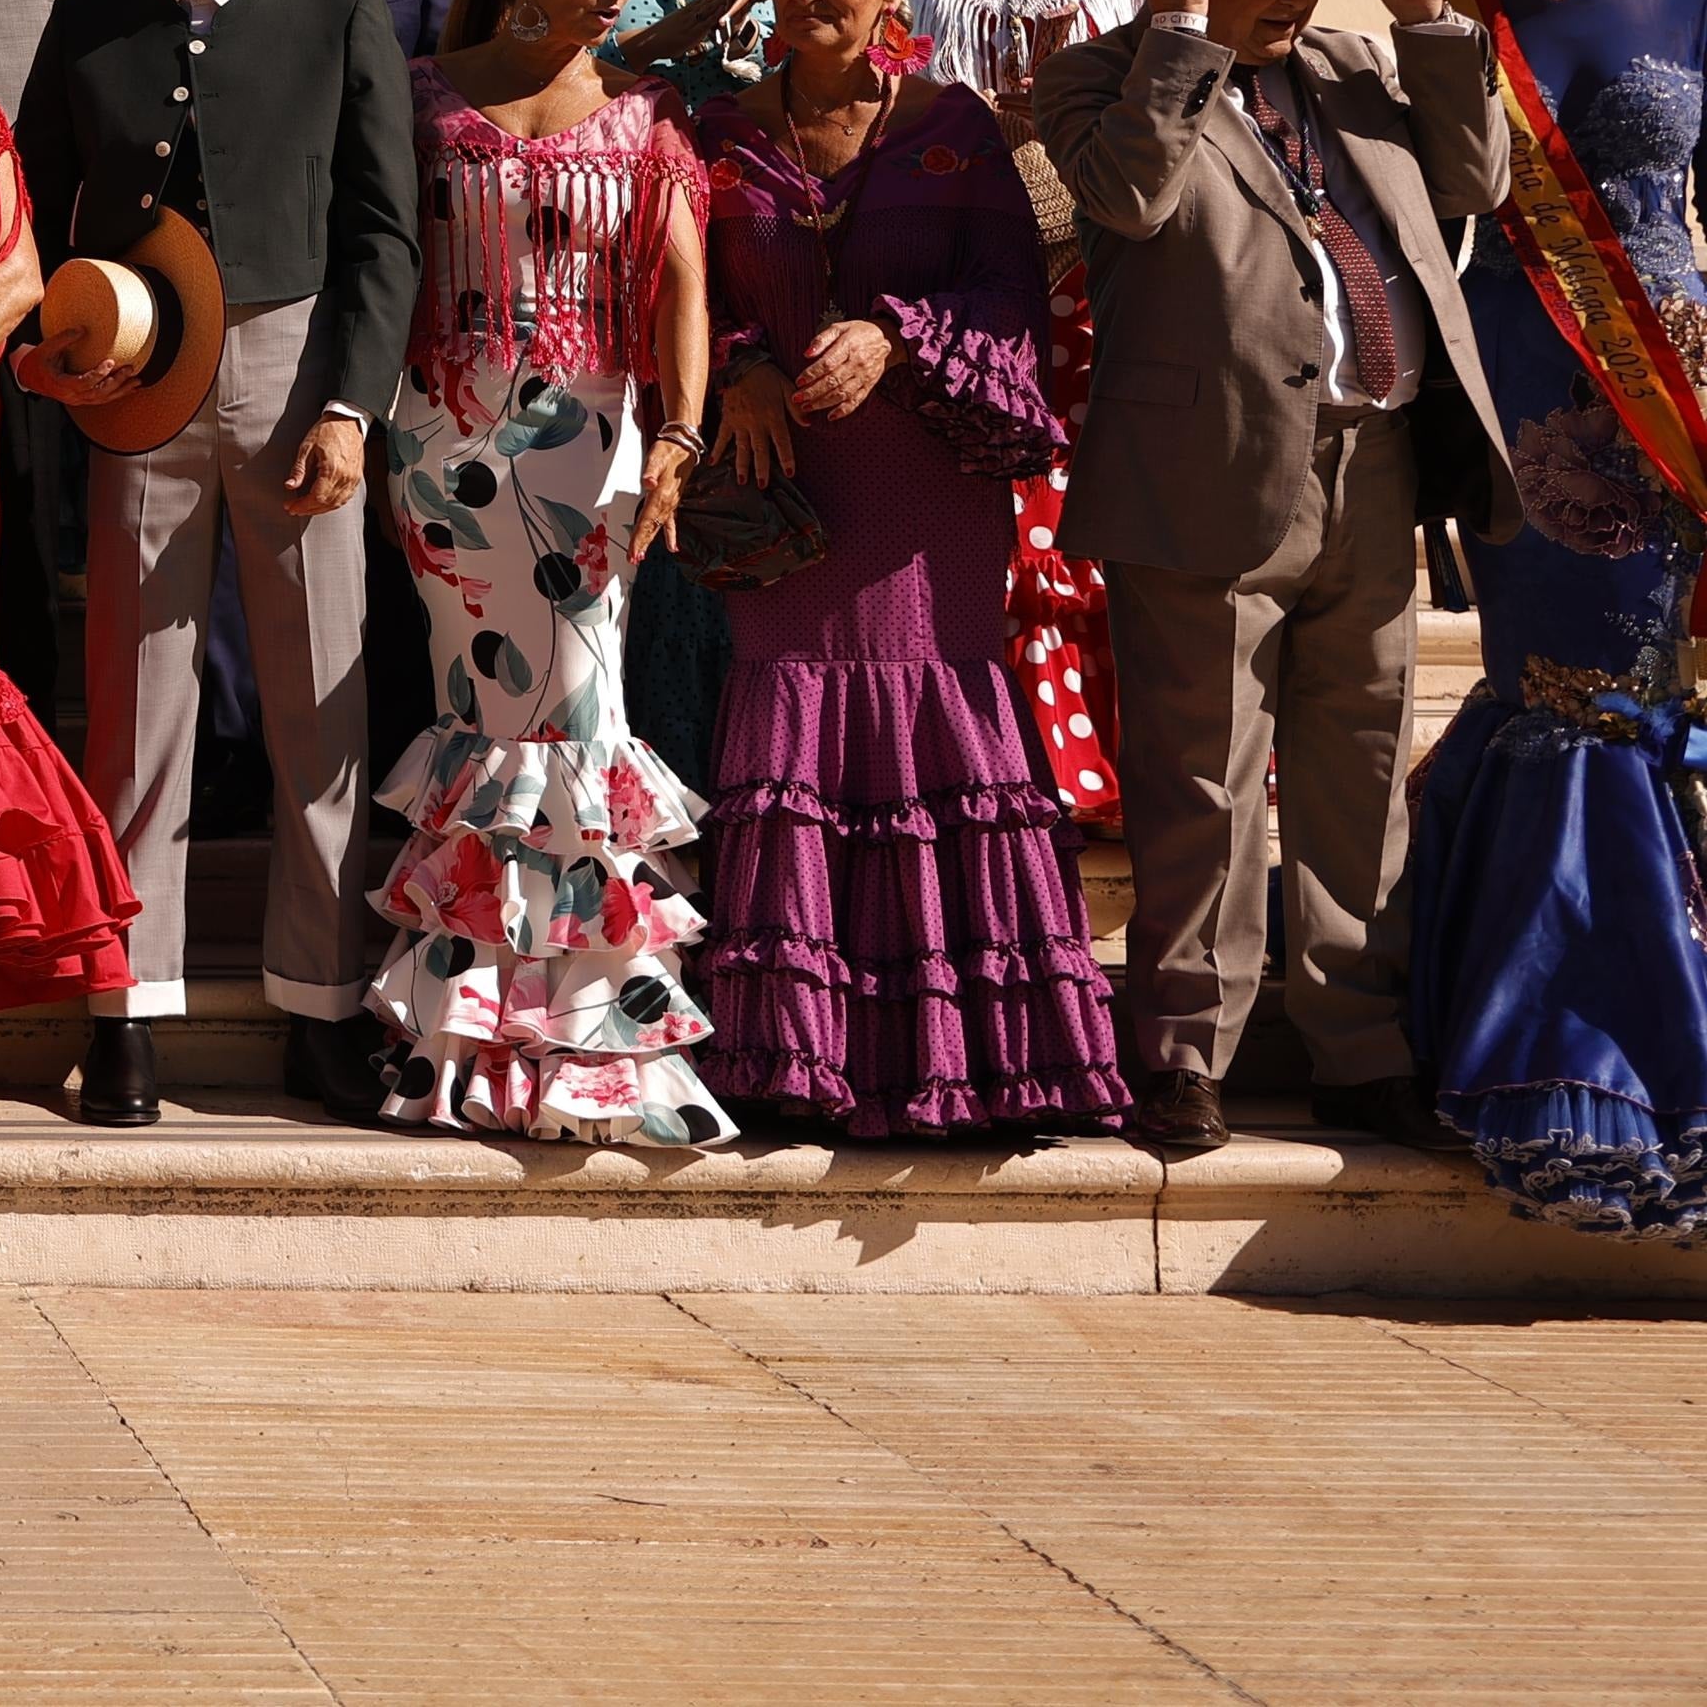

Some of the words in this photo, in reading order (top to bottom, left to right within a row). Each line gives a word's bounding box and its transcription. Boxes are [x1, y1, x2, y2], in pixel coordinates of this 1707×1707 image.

[1170, 15, 1197, 25] CITY
[1531, 203, 1570, 227] de
[1547, 237, 1611, 325] Málaga
[1601, 336, 1656, 399] 2023
